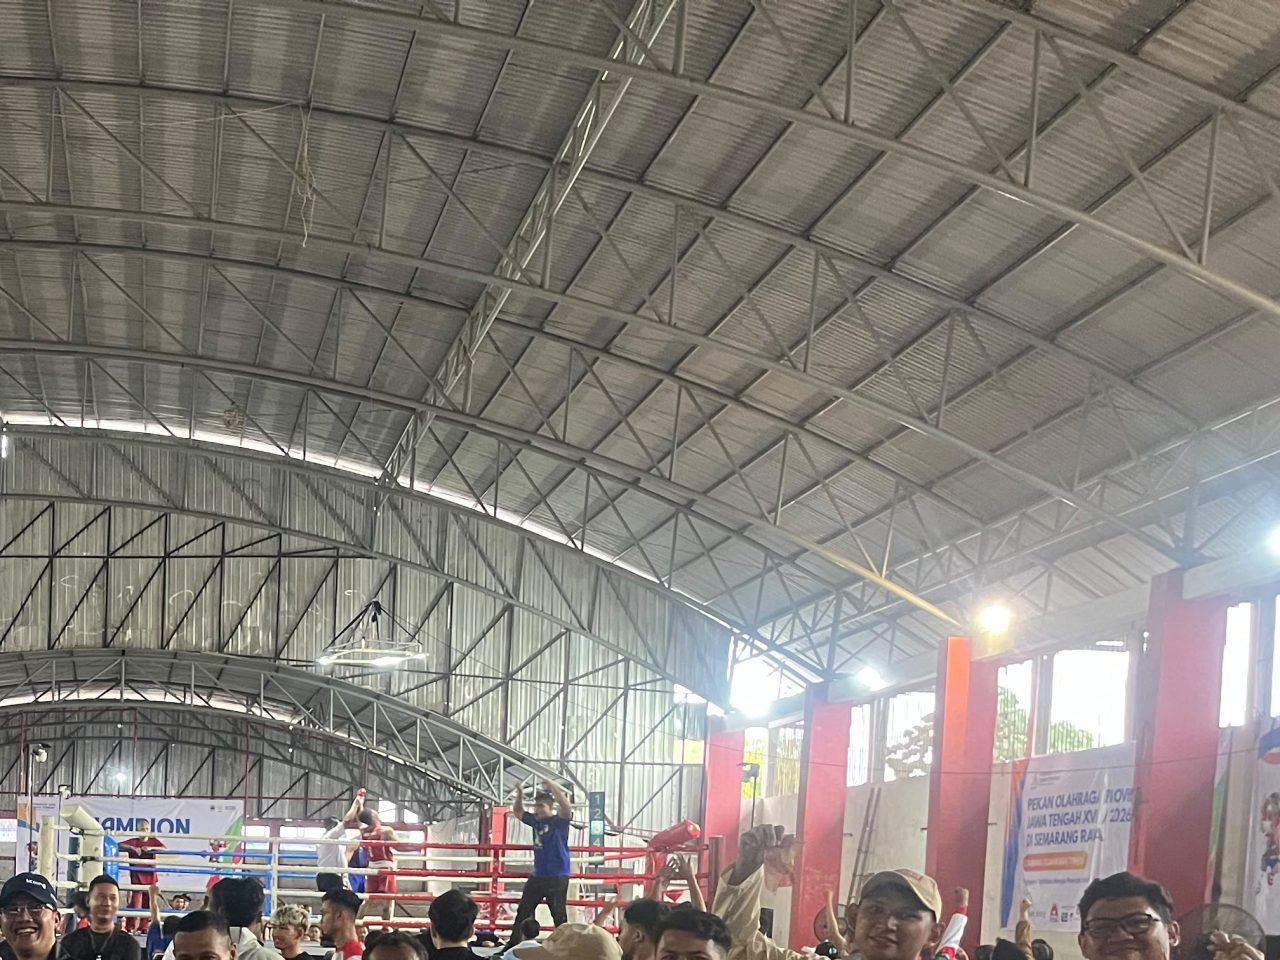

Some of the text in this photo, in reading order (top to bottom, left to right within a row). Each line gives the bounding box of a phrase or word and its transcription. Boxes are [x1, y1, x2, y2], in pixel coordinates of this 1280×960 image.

[594, 794, 600, 805] 1
[1027, 796, 1054, 811] PEKAN
[593, 808, 601, 819] 2
[1048, 811, 1082, 827] TENGAH
[95, 817, 190, 834] AMION
[1034, 830, 1079, 846] SEMARANG
